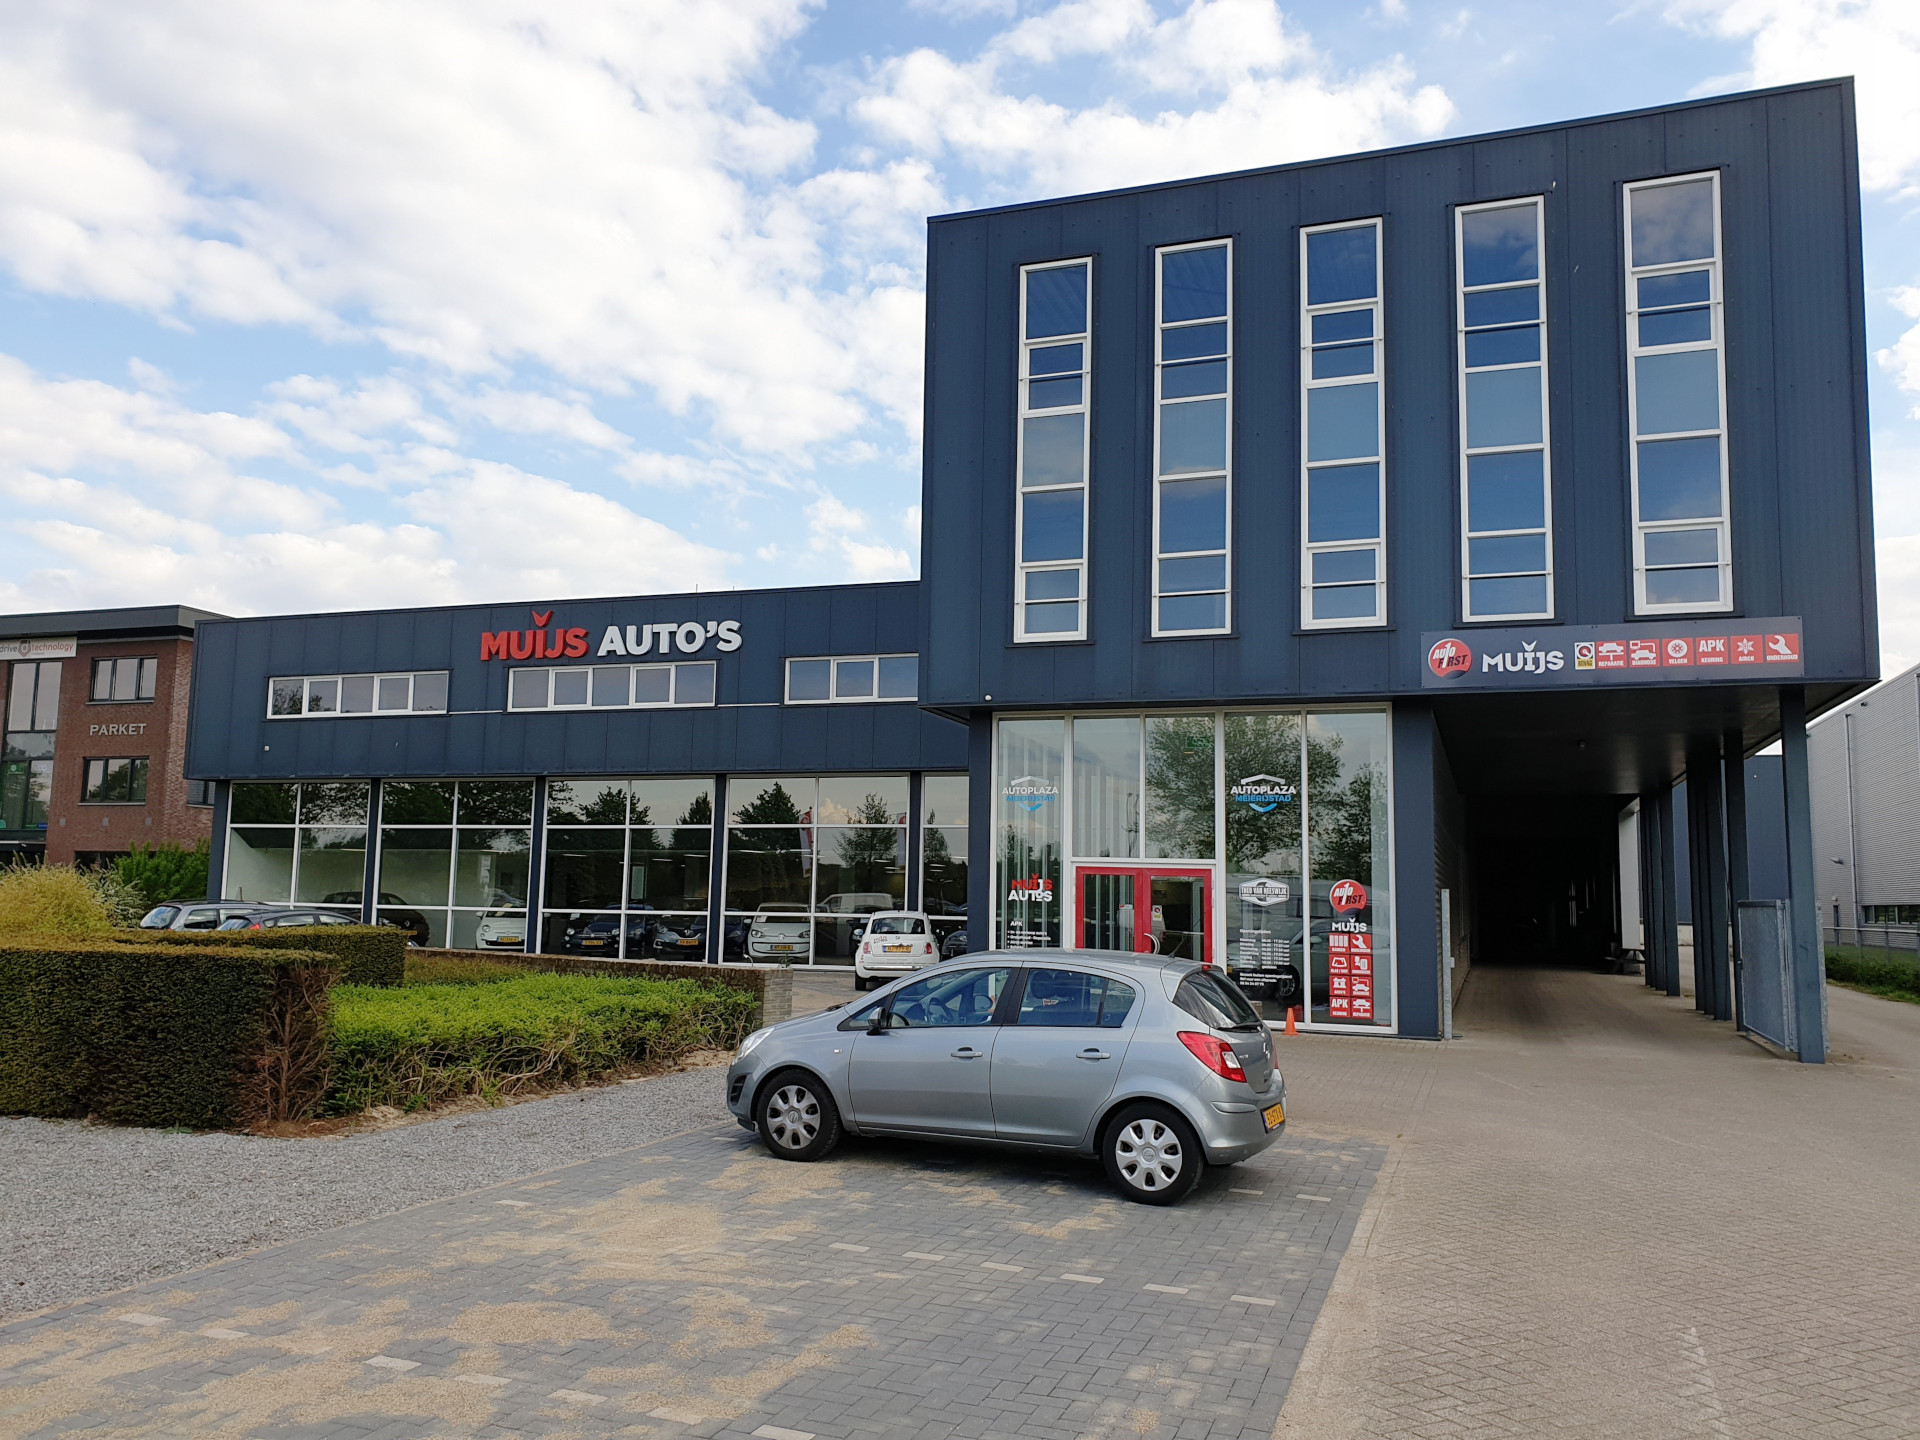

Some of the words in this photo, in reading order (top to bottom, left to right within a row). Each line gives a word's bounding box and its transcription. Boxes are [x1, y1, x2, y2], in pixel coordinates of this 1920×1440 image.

[480, 610, 589, 661] MUIJS
[596, 620, 743, 657] AUTO'S
[31, 642, 74, 652] technology
[1699, 639, 1725, 652] APK
[90, 723, 147, 736] PARKET
[1001, 786, 1059, 795] AUTOPLAZA
[1230, 785, 1297, 795] AUTOPLAZA
[1235, 794, 1292, 802] MEIERIJSTAD
[1331, 998, 1348, 1008] APK
